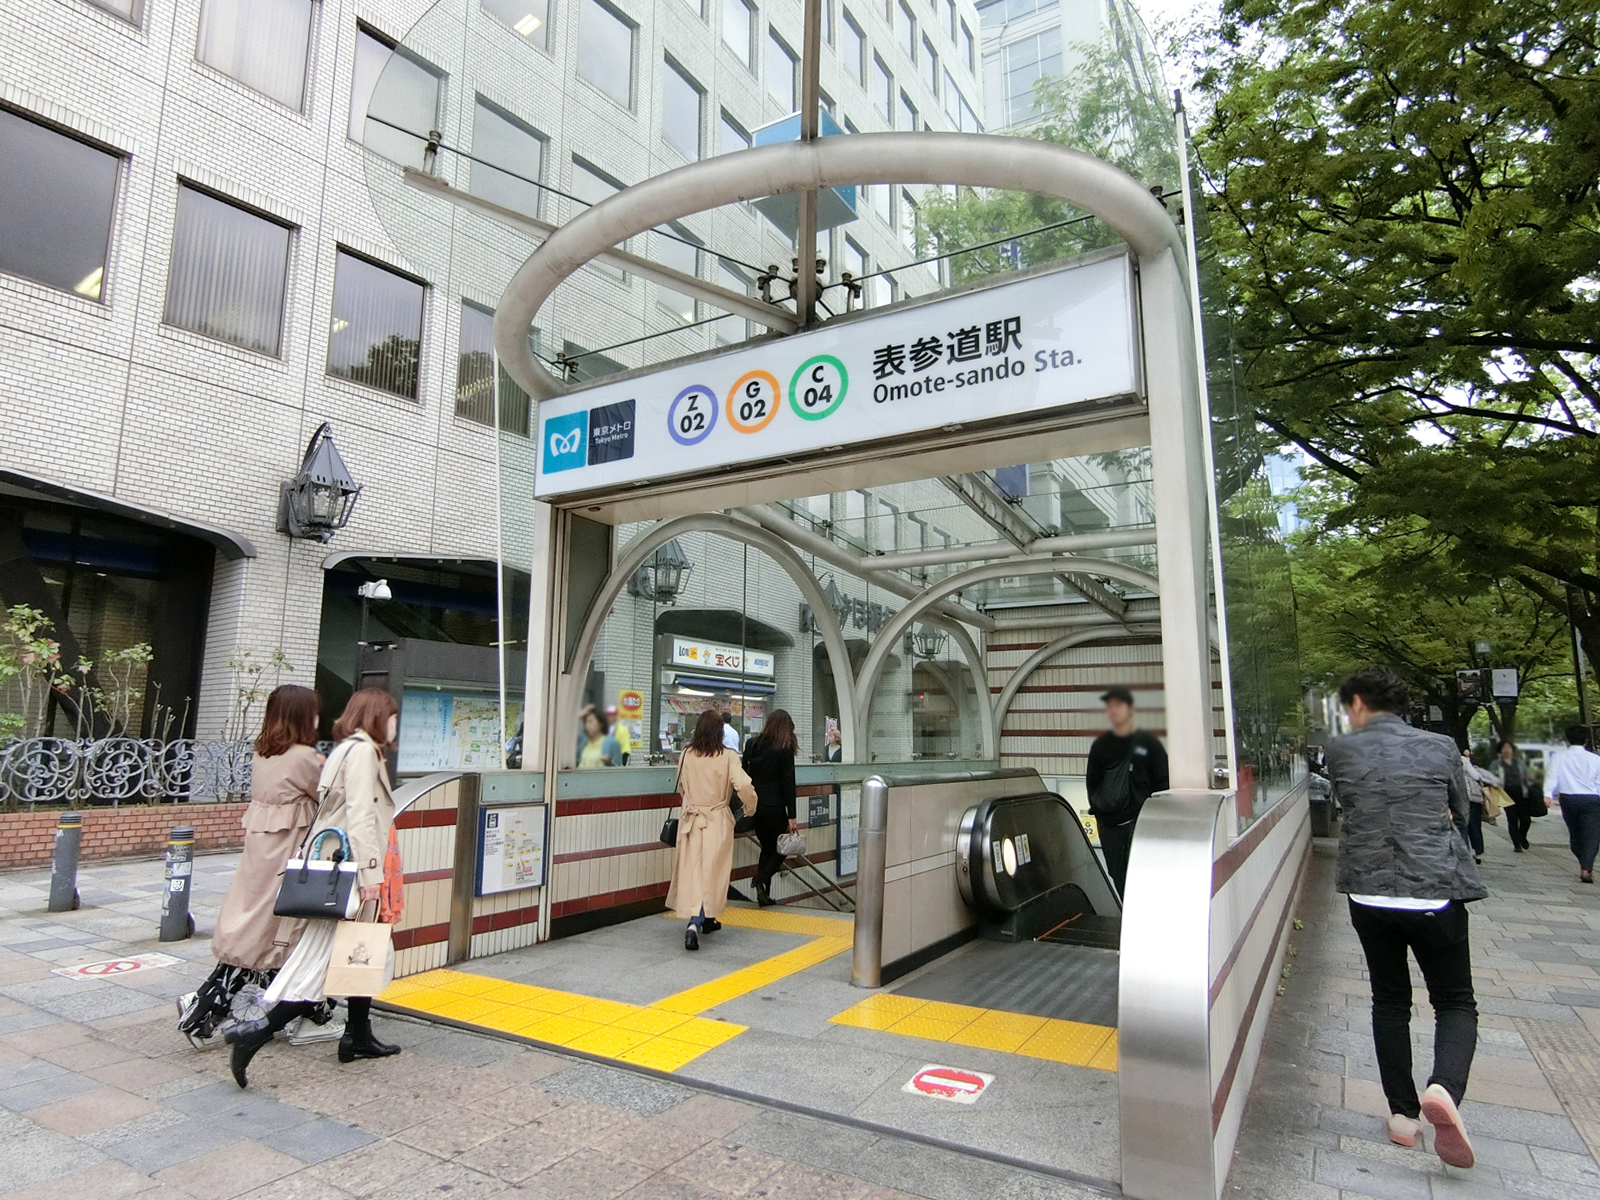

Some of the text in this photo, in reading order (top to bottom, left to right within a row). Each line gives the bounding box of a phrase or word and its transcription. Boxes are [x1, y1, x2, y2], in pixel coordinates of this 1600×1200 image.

[872, 316, 1023, 381] 表参道駅
[812, 365, 824, 383] C
[873, 348, 1083, 404] Omote-sando Sta.
[745, 381, 761, 398] G
[803, 384, 833, 408] 04
[687, 395, 699, 412] Z
[739, 399, 766, 421] 02
[592, 421, 631, 438] 東京メトロ
[680, 412, 705, 433] 02
[594, 433, 629, 445] Tokyo Metro
[715, 653, 740, 668] 宝くじ
